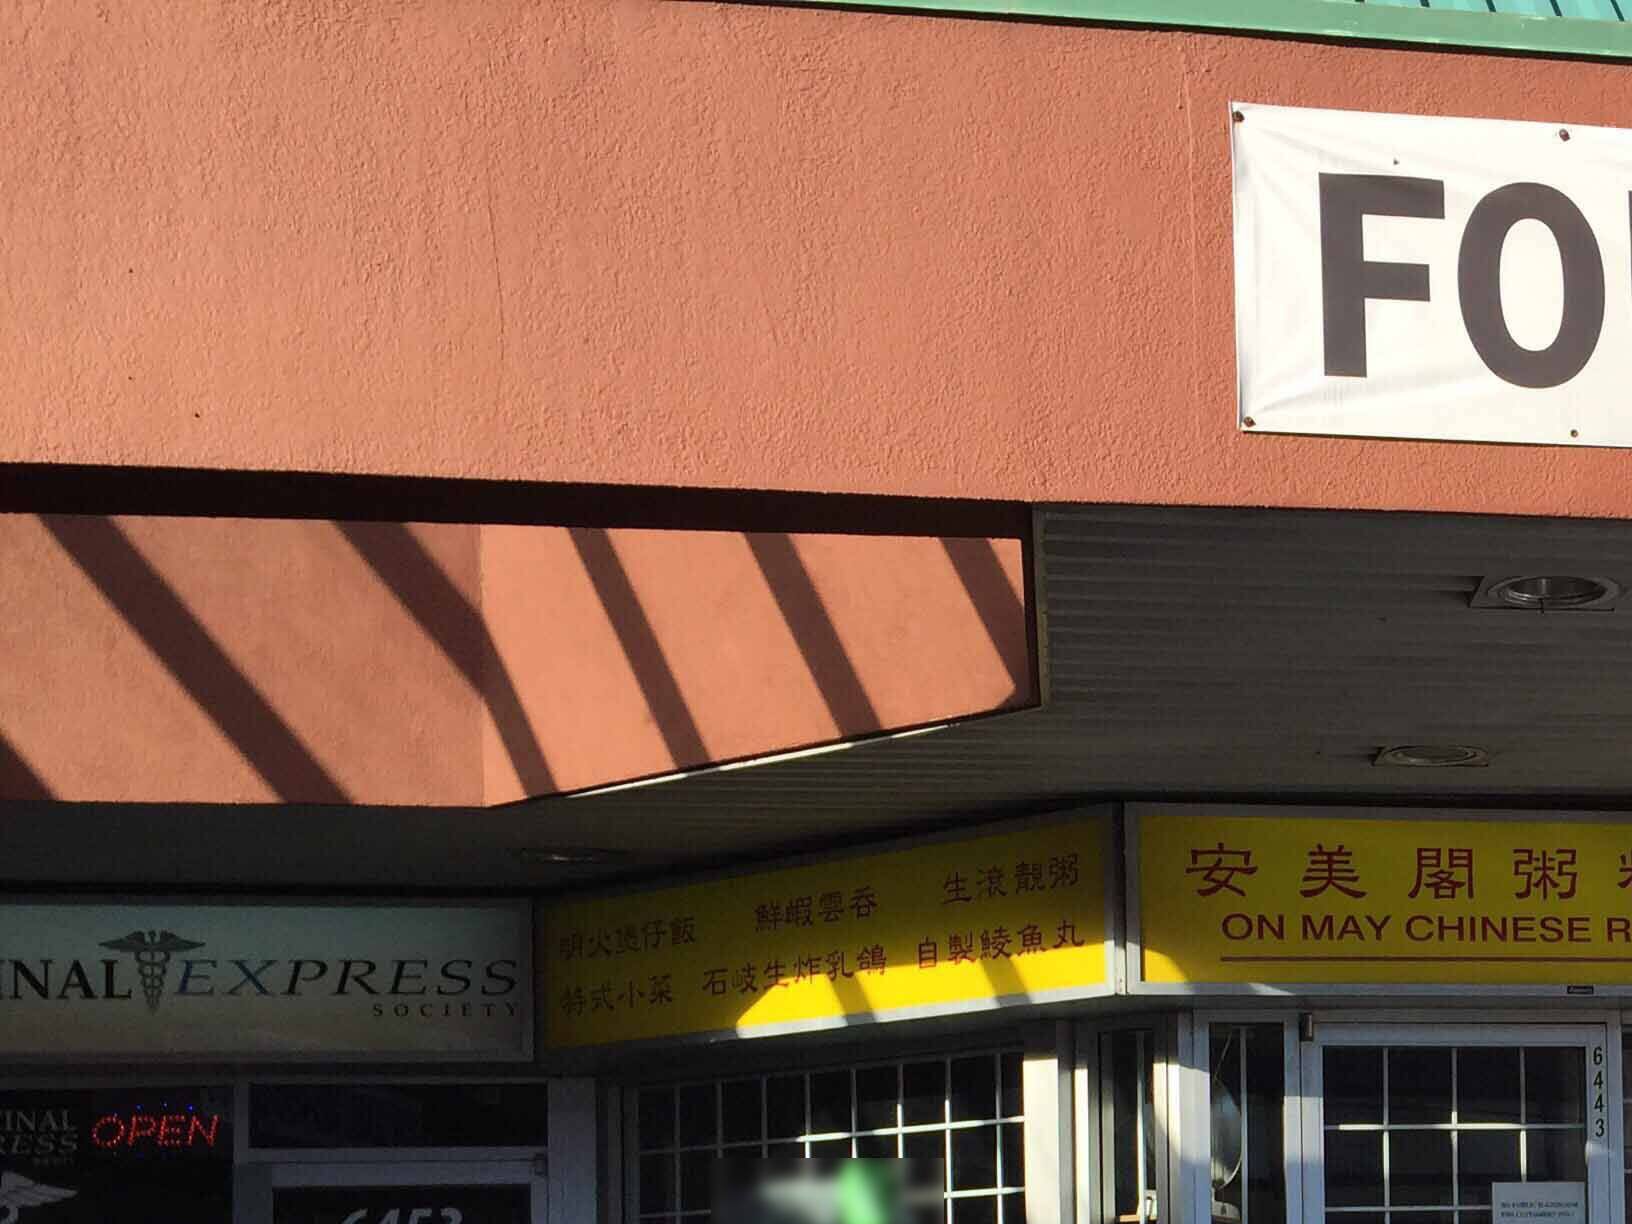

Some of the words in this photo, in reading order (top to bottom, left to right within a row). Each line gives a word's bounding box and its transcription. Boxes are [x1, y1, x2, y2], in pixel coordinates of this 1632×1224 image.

[1221, 913, 1285, 940] ON
[1300, 914, 1390, 942] MAY
[1405, 914, 1592, 943] CHINESE
[0, 960, 132, 1000] NAL
[173, 959, 520, 996] EXPRESS
[372, 1002, 519, 1018] SOCIETY
[1593, 1046, 1604, 1137] 6443
[0, 1110, 78, 1131] INAL
[90, 1112, 220, 1149] OPEN
